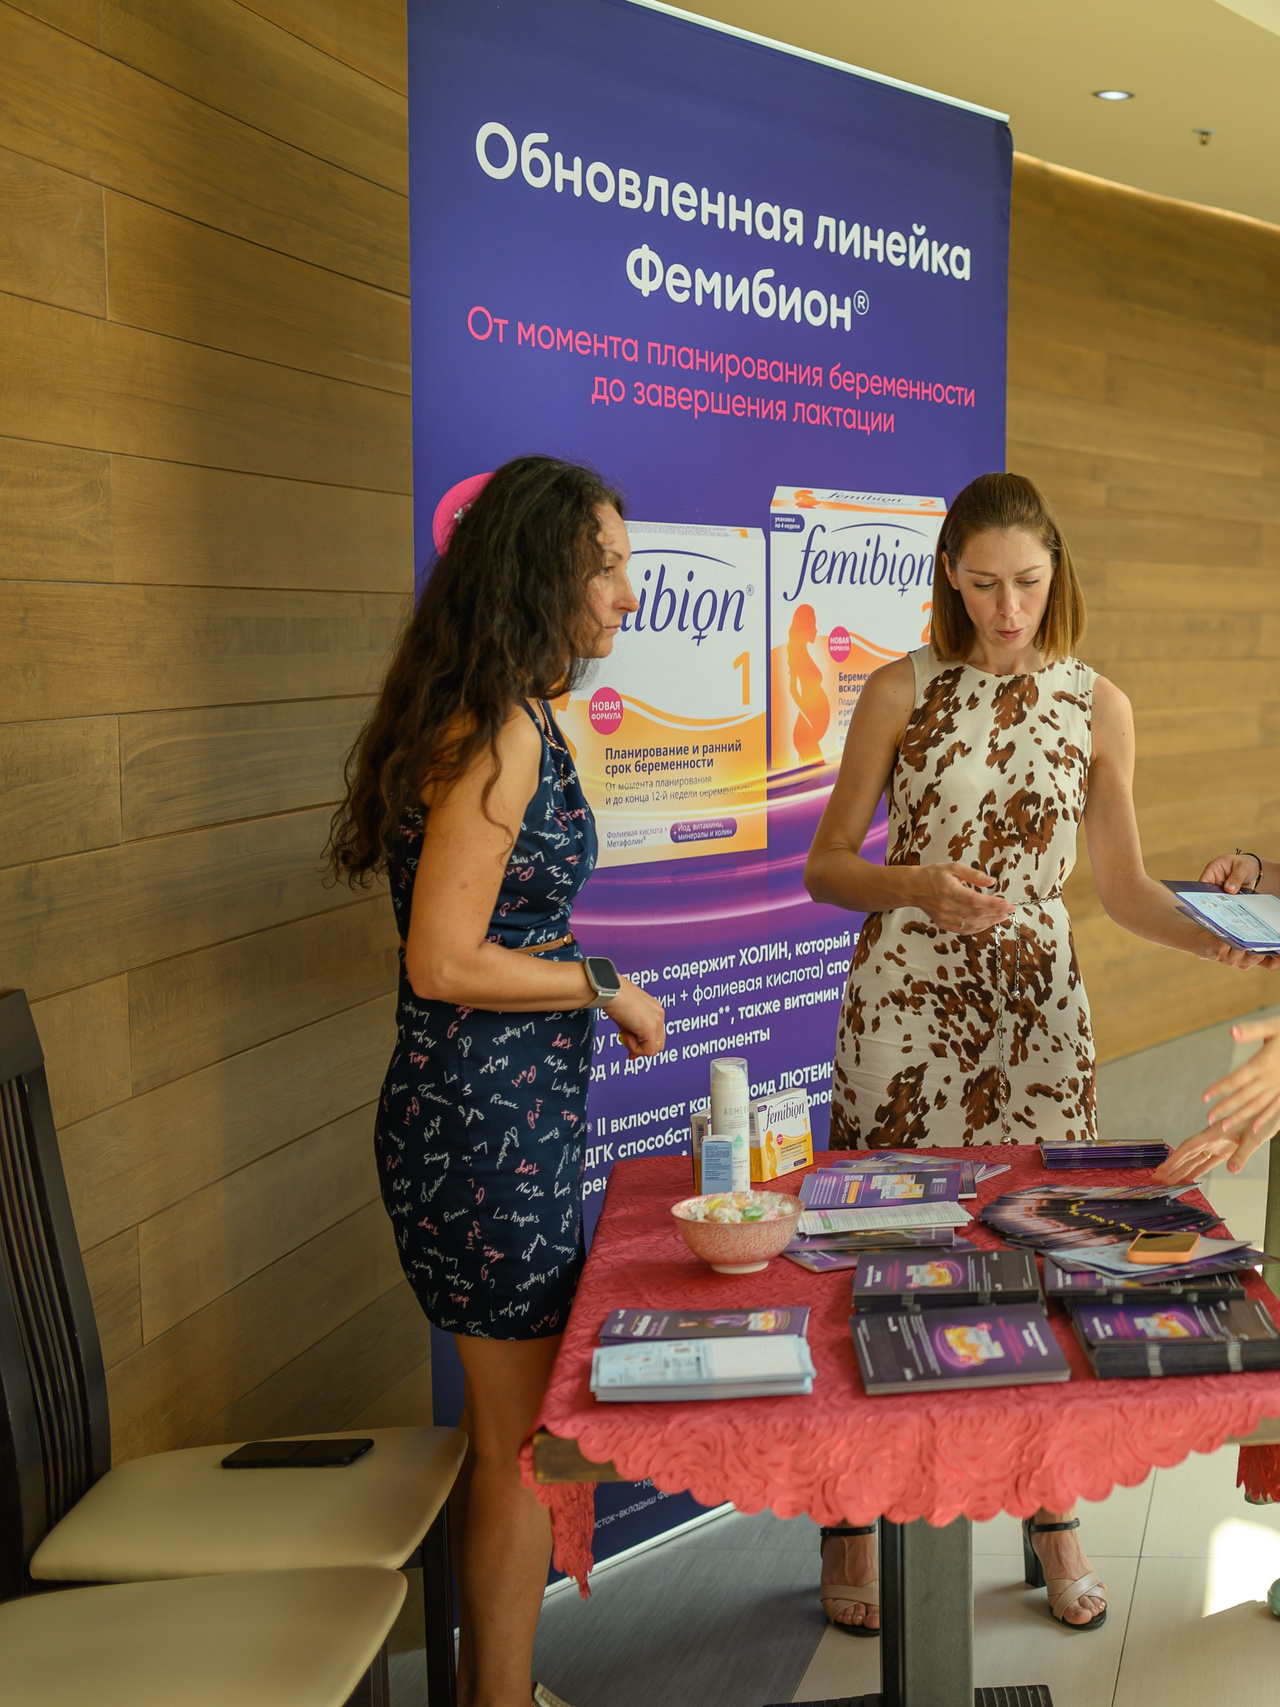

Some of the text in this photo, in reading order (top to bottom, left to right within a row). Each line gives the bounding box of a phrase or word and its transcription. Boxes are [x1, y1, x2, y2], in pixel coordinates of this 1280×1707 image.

[475, 121, 972, 281] Обновленная линейка
[467, 306, 975, 408] От момента планирования беременности
[591, 374, 895, 435] до завершения лактации
[733, 652, 750, 706] 1
[591, 712, 621, 720] ФОРМУЛА
[592, 701, 620, 711] НОВАЯ
[605, 740, 742, 761] Планирование и ранний
[605, 758, 714, 777] срок беременности
[605, 776, 712, 791] От момента планирования
[605, 797, 611, 805] и
[613, 795, 623, 806] до
[625, 794, 649, 804] конца
[652, 791, 668, 801] 12-й
[670, 790, 698, 801] недели
[607, 828, 663, 839] Фолиевая кислота
[663, 954, 736, 980] содержит
[739, 941, 791, 966] ХОЛИН,
[795, 931, 850, 956] который
[692, 977, 762, 1006] фолиевая
[766, 958, 824, 988] кислота)
[738, 999, 781, 1020] также
[784, 987, 839, 1010] витамин
[610, 1061, 620, 1076] и
[624, 1048, 678, 1076] другие
[682, 1028, 770, 1059] компоненты
[611, 1102, 686, 1133] включает
[618, 1127, 691, 1158] способст
[493, 1206, 540, 1228] Los Angeles
[594, 1496, 657, 1529] сток-вкладыш
